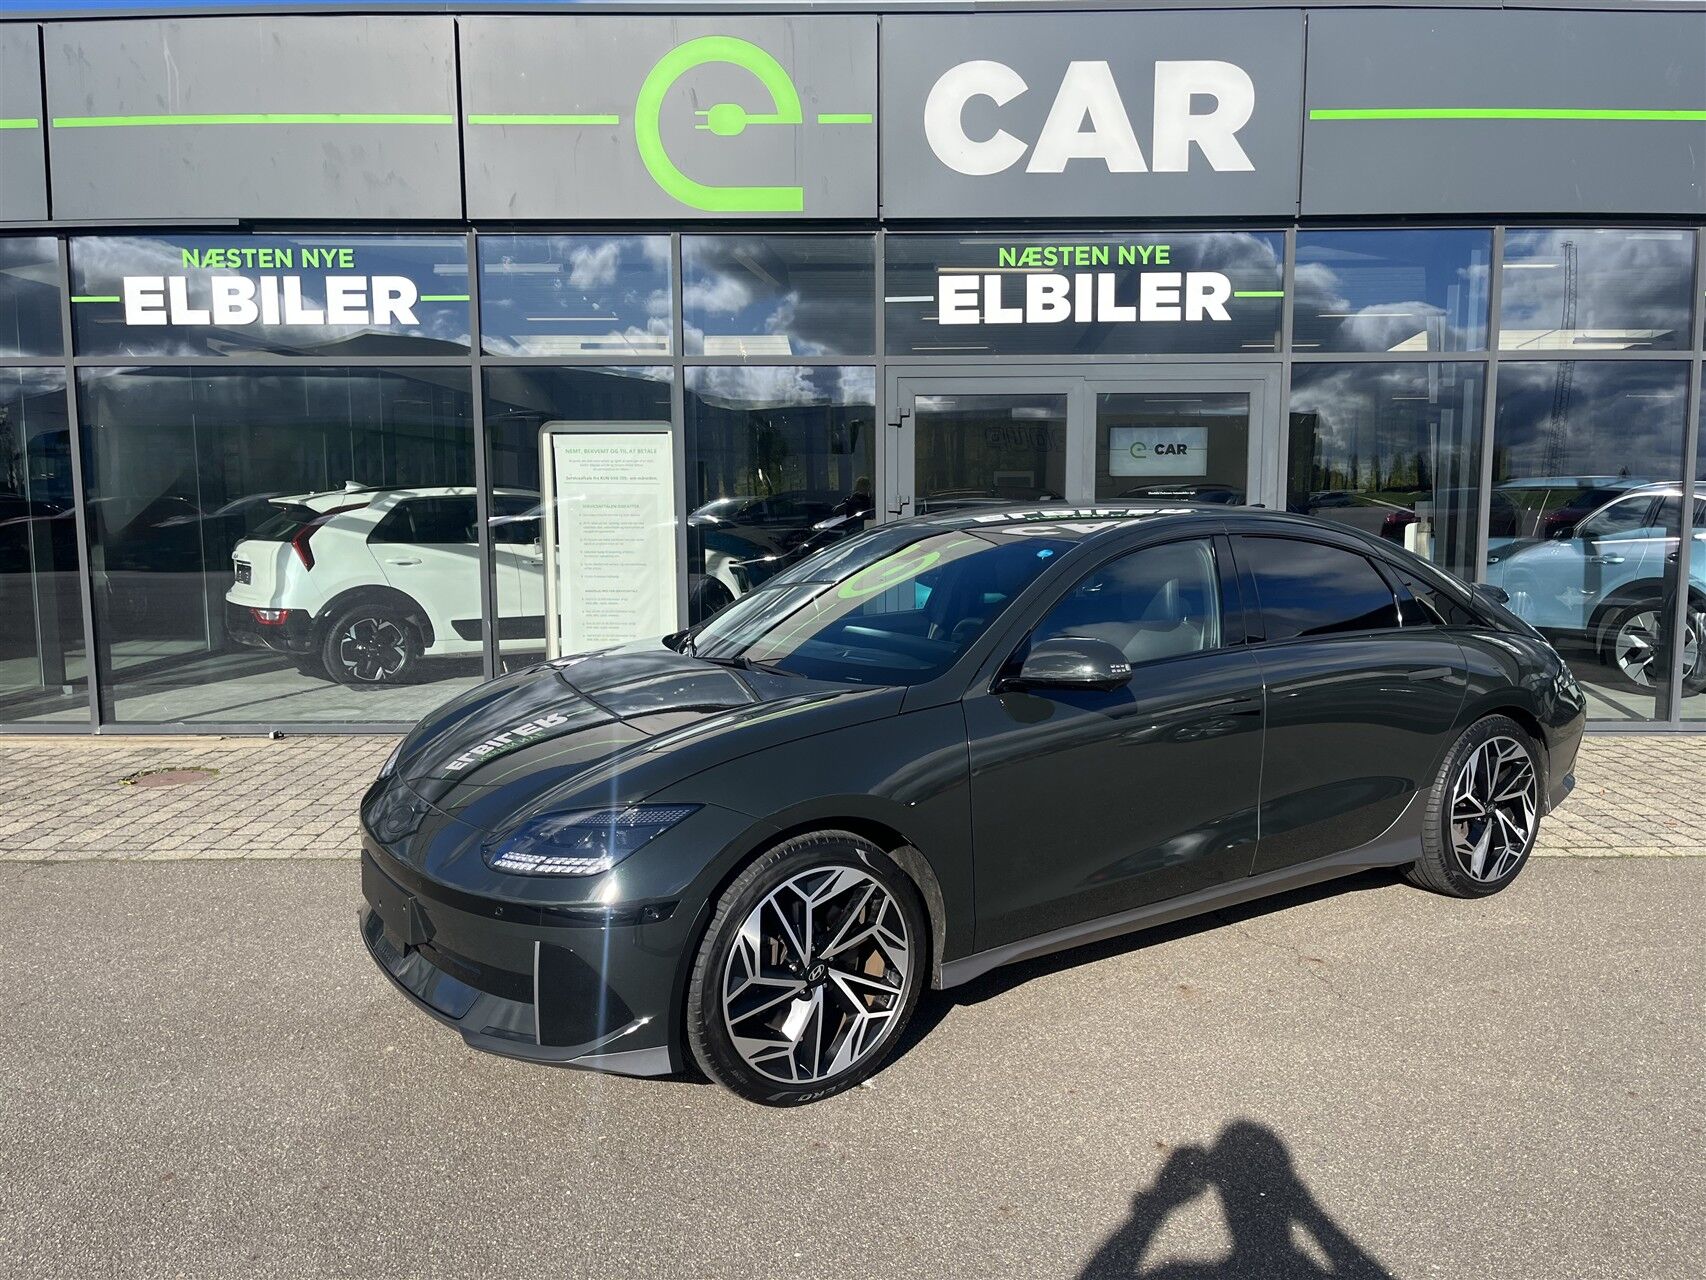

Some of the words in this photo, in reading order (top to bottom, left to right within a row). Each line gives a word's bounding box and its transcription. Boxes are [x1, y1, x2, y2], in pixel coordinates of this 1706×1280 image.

[923, 59, 1257, 176] CAR
[181, 248, 293, 269] NÆSTEN
[301, 248, 355, 268] NYE
[998, 246, 1109, 267] NÆSTEN
[1117, 245, 1171, 266] NYE
[123, 275, 420, 327] ELBILER
[937, 271, 1232, 325] ELBILER
[1154, 443, 1188, 455] CAR
